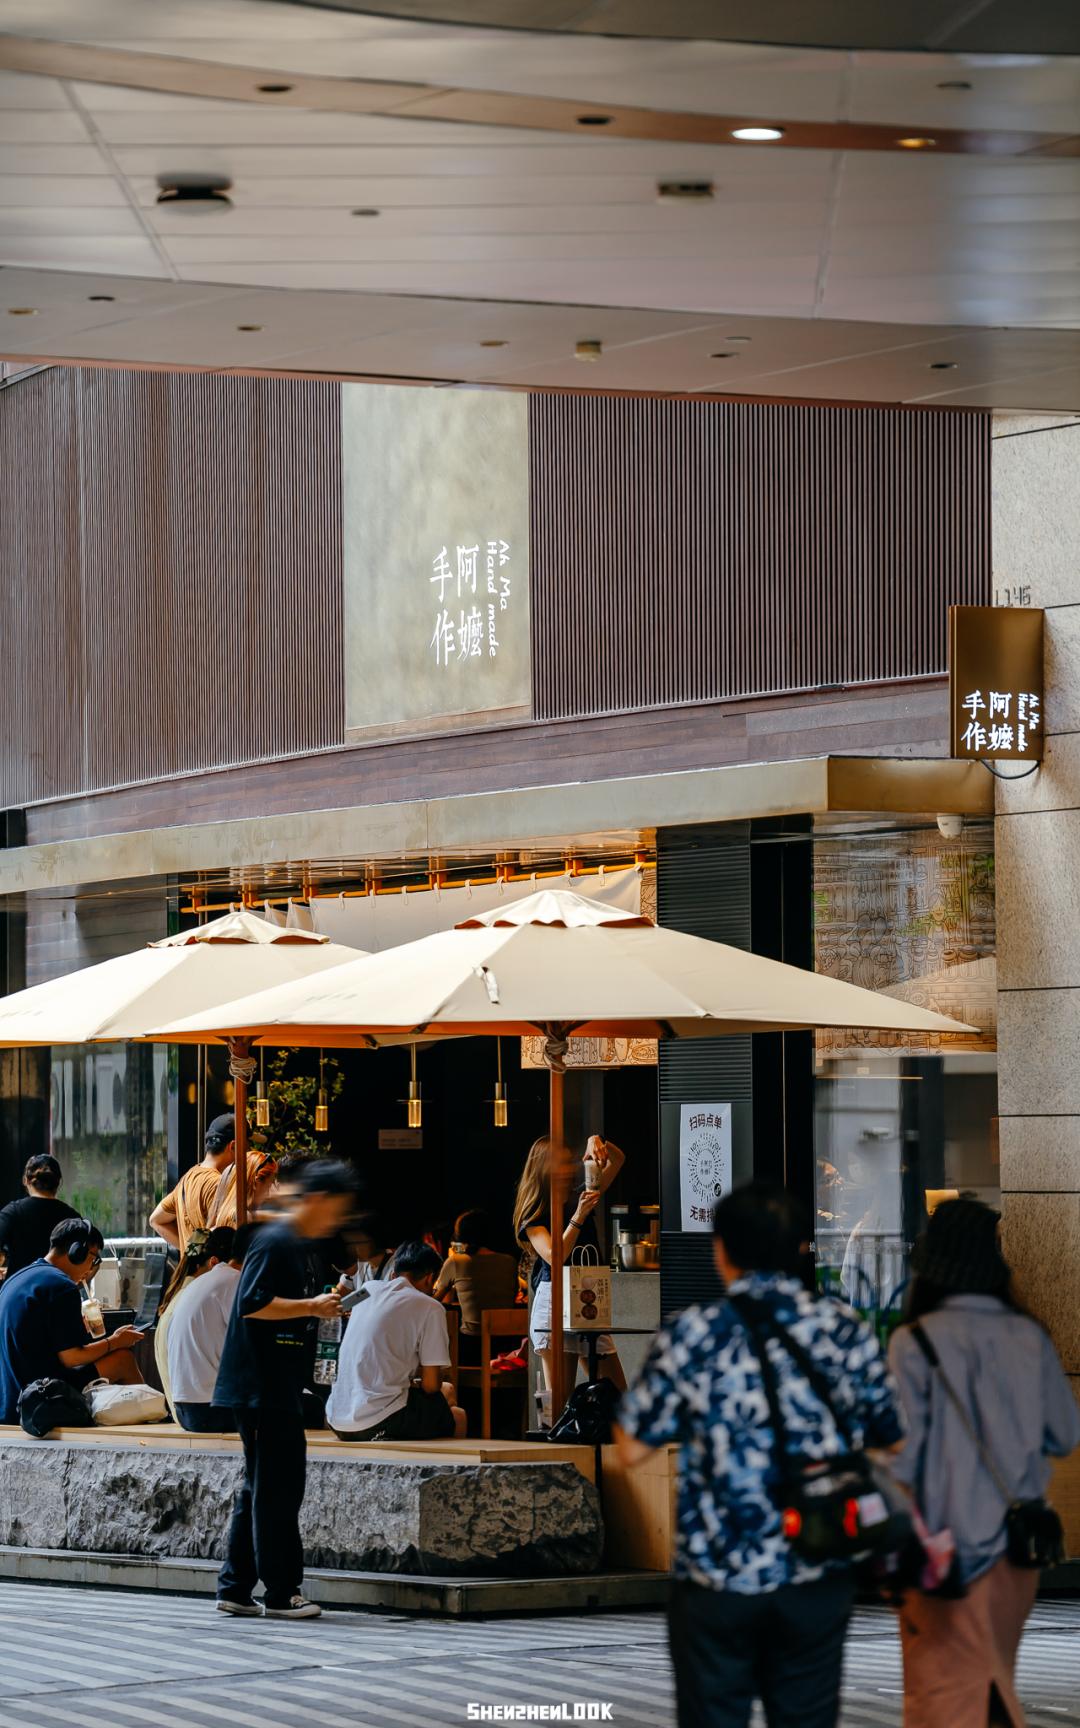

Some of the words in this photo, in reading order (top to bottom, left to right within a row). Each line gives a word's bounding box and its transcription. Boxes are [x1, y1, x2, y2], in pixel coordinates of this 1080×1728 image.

[487, 541, 498, 593] Hand
[499, 540, 511, 566] Ah
[499, 576, 511, 610] Ma
[487, 603, 499, 657] made
[689, 1113, 722, 1131] 扫码点单
